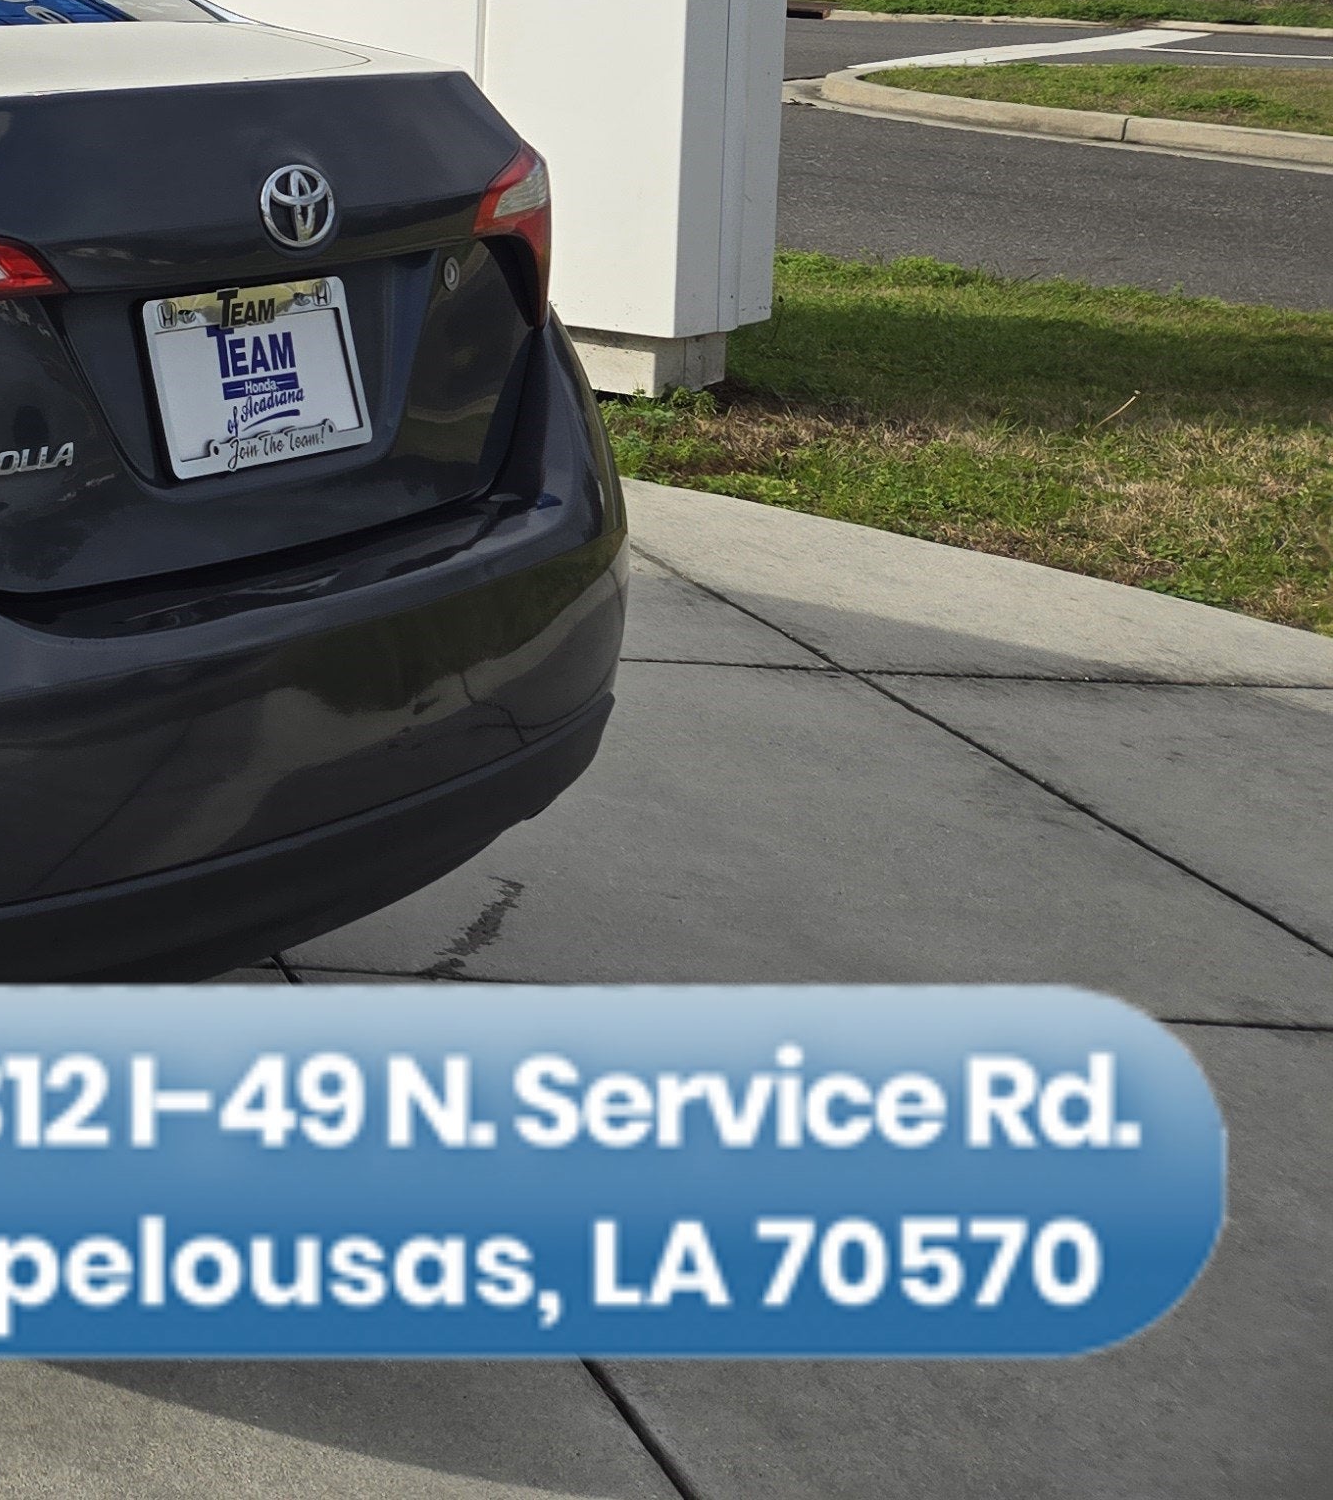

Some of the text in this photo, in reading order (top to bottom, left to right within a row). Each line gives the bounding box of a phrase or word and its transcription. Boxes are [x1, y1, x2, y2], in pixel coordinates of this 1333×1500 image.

[216, 288, 275, 328] TEAM
[206, 326, 296, 379] TEAM
[244, 378, 277, 394] Honda
[227, 388, 305, 437] of Acadiana
[227, 425, 325, 470] Join The Team!
